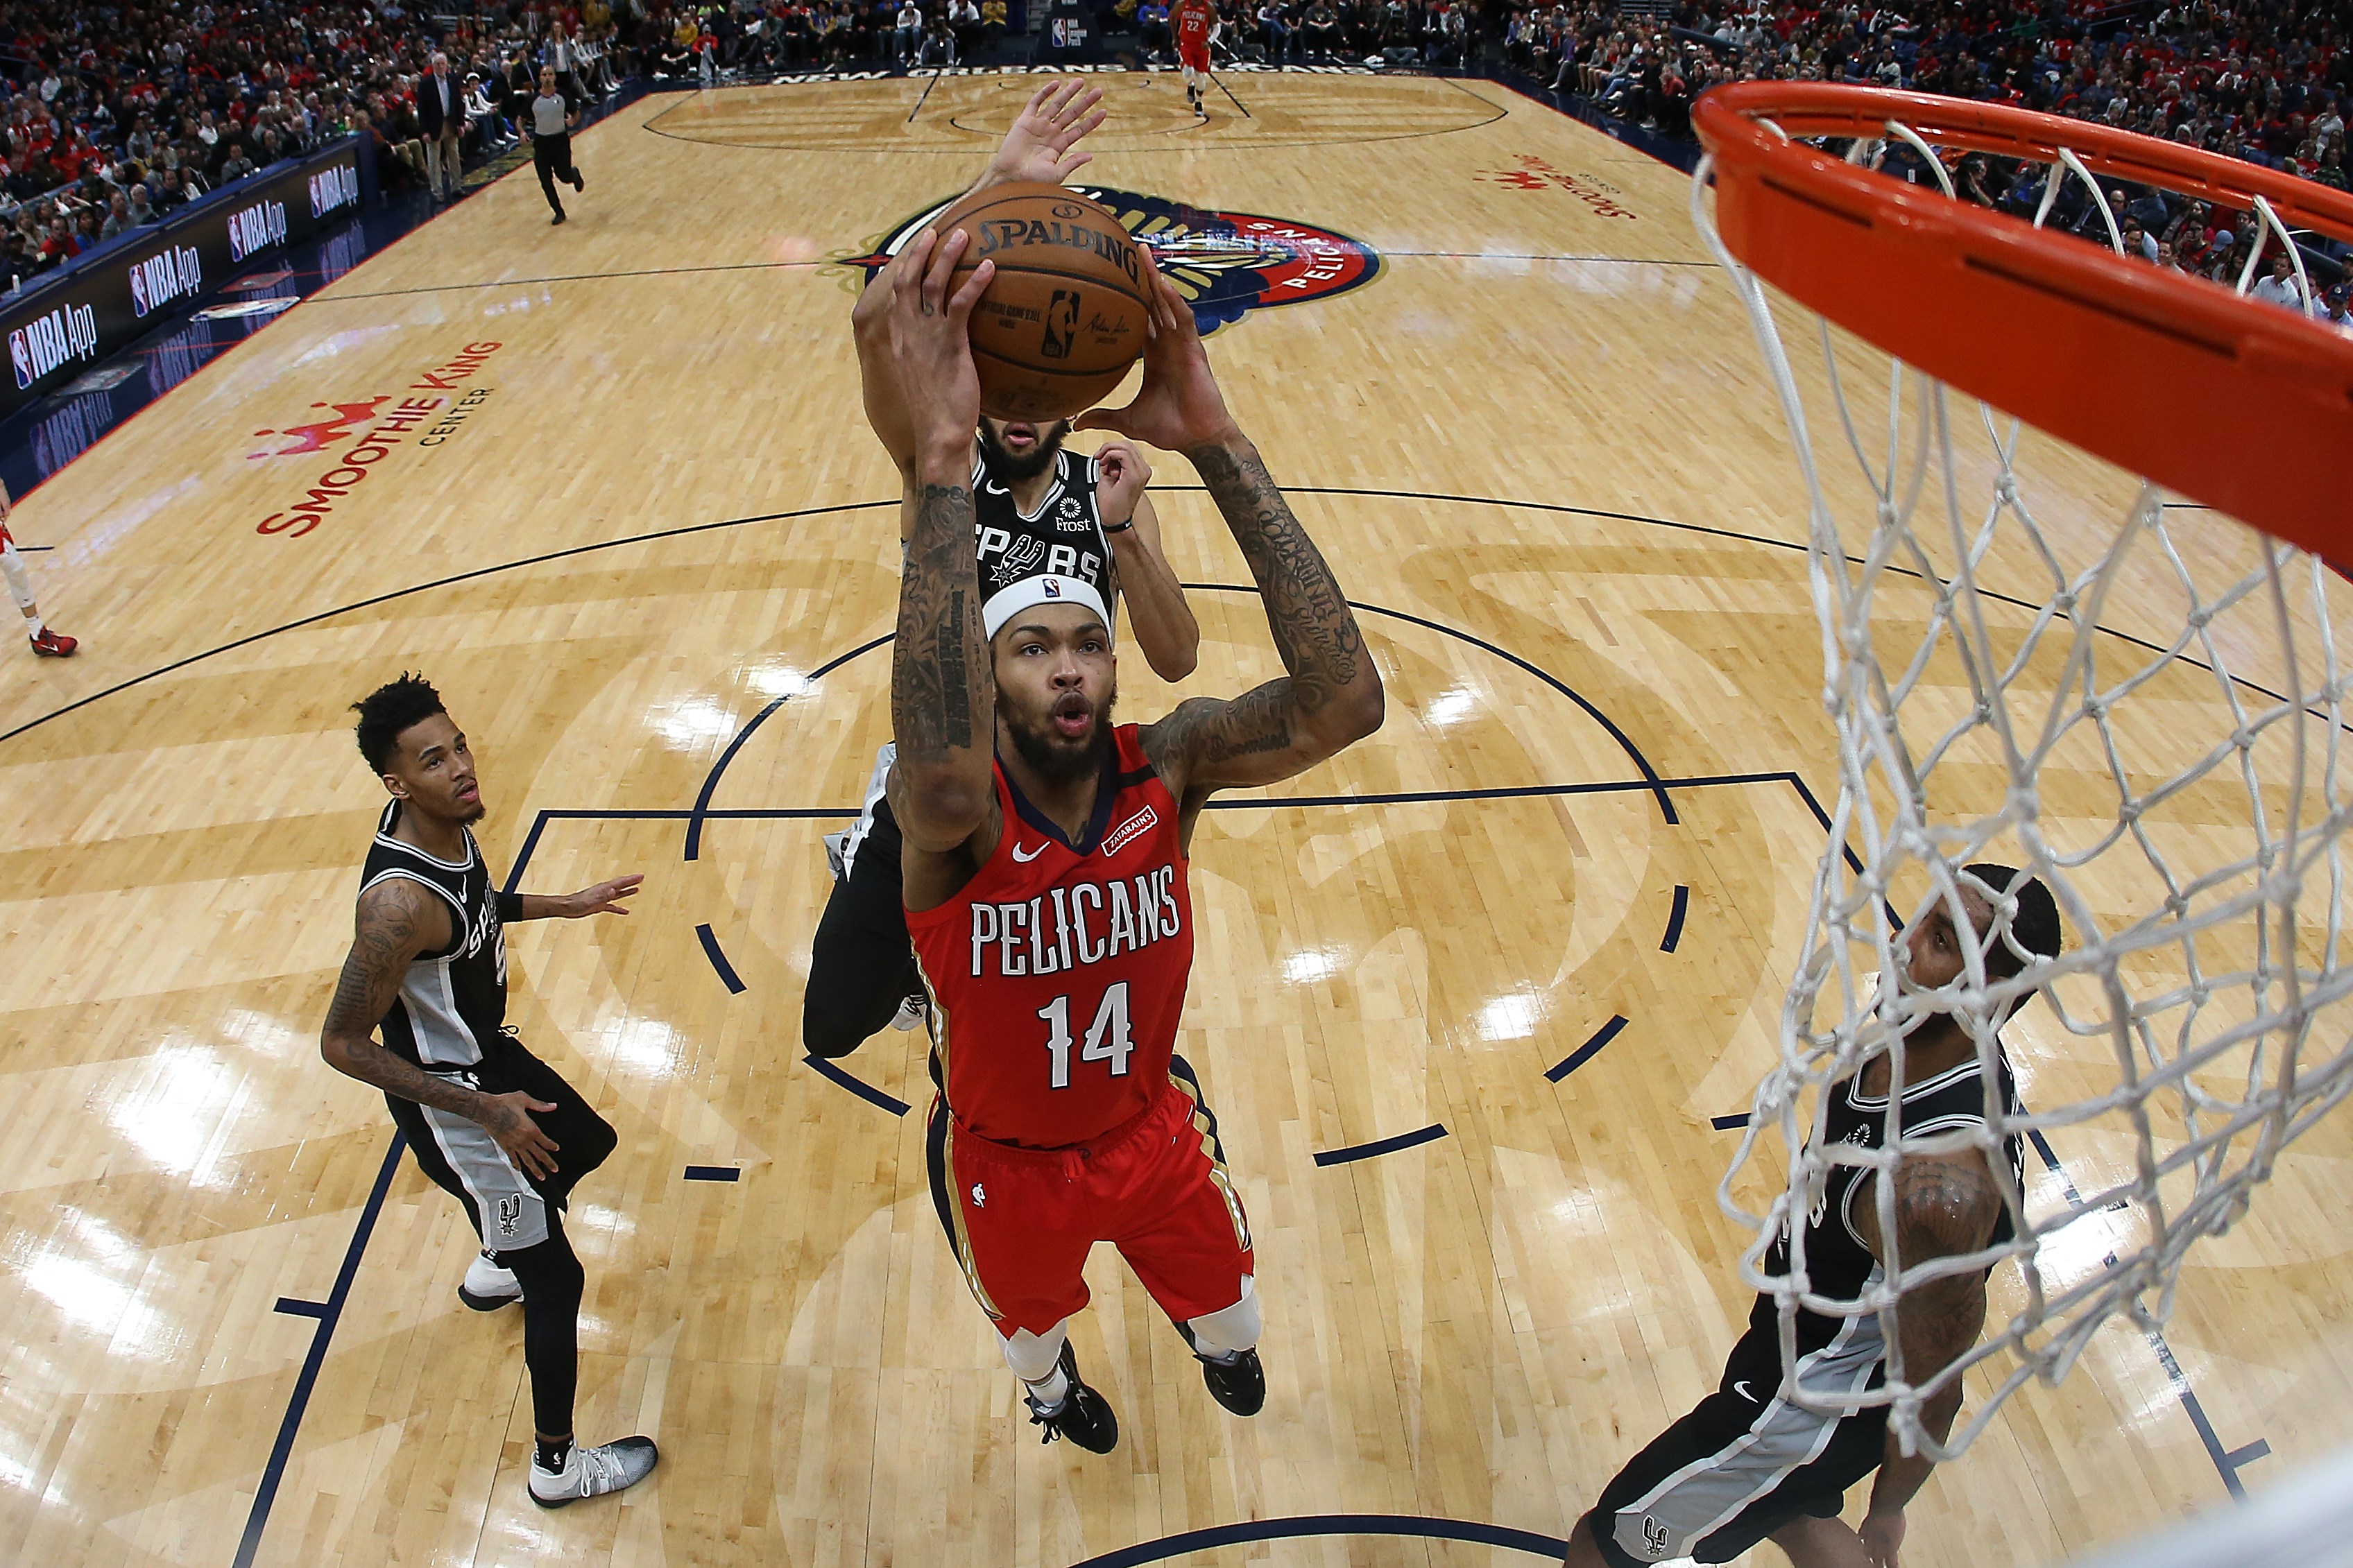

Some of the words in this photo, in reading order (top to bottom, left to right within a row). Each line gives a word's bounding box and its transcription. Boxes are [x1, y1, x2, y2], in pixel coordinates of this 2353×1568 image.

[1187, 19, 1199, 32] 22
[772, 70, 891, 85] NEW
[907, 64, 1127, 78] ORLEANS
[318, 165, 343, 214] NBA
[238, 202, 268, 257] NBA
[264, 198, 287, 248] App
[978, 218, 1140, 286] SPALDING
[1247, 222, 1344, 289] PELICANS
[142, 248, 180, 310] NBA
[174, 244, 202, 298] App
[25, 309, 71, 379] NBA
[65, 303, 97, 361] App
[419, 388, 495, 447] CENTER
[256, 397, 443, 538] SMOOTHIE
[975, 523, 1101, 589] PURS
[1054, 516, 1092, 532] Frost
[1109, 811, 1152, 848] ZATARAINS
[970, 865, 1181, 976] PELICANS
[1036, 979, 1135, 1090] 14
